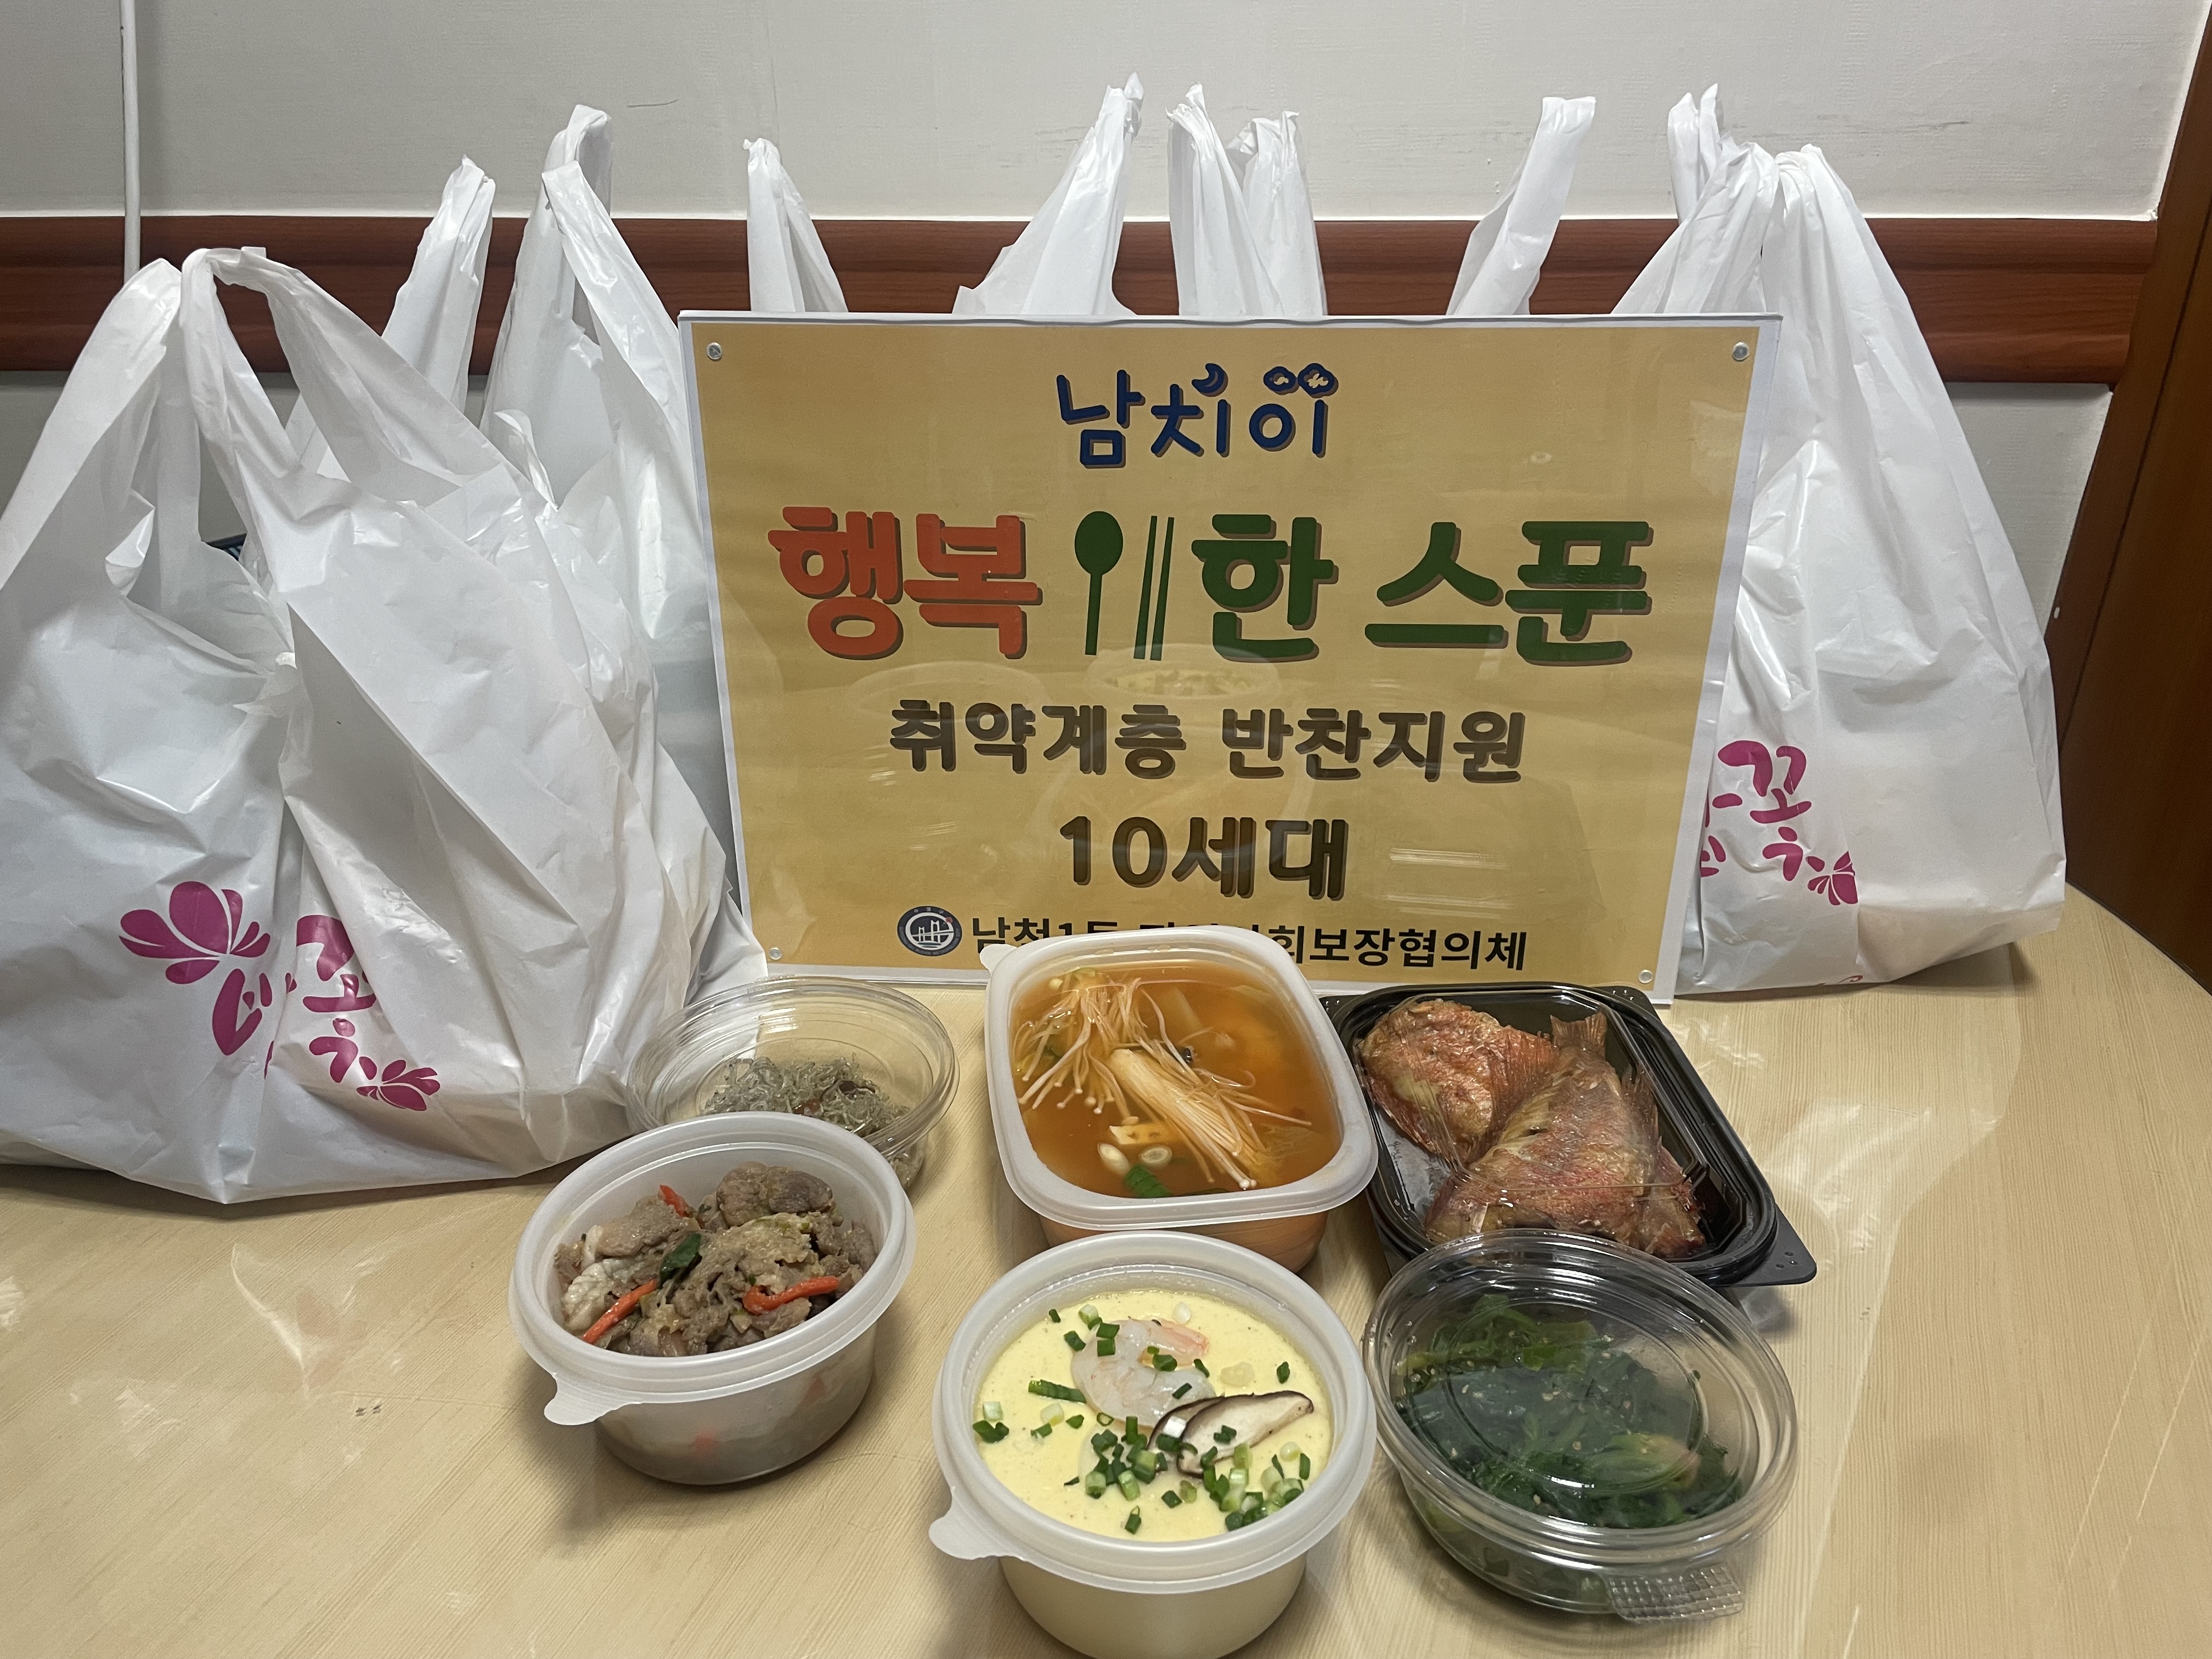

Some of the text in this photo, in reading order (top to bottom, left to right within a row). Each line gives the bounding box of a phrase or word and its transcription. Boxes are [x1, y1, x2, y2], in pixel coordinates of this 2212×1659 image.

[1057, 363, 1339, 468] 남치이
[768, 506, 1654, 667] 행복 한 스푼
[890, 700, 1525, 783] 취약계층 반찬지원
[1060, 816, 1348, 901] 10세대
[1139, 922, 1527, 971] 회보장협의체
